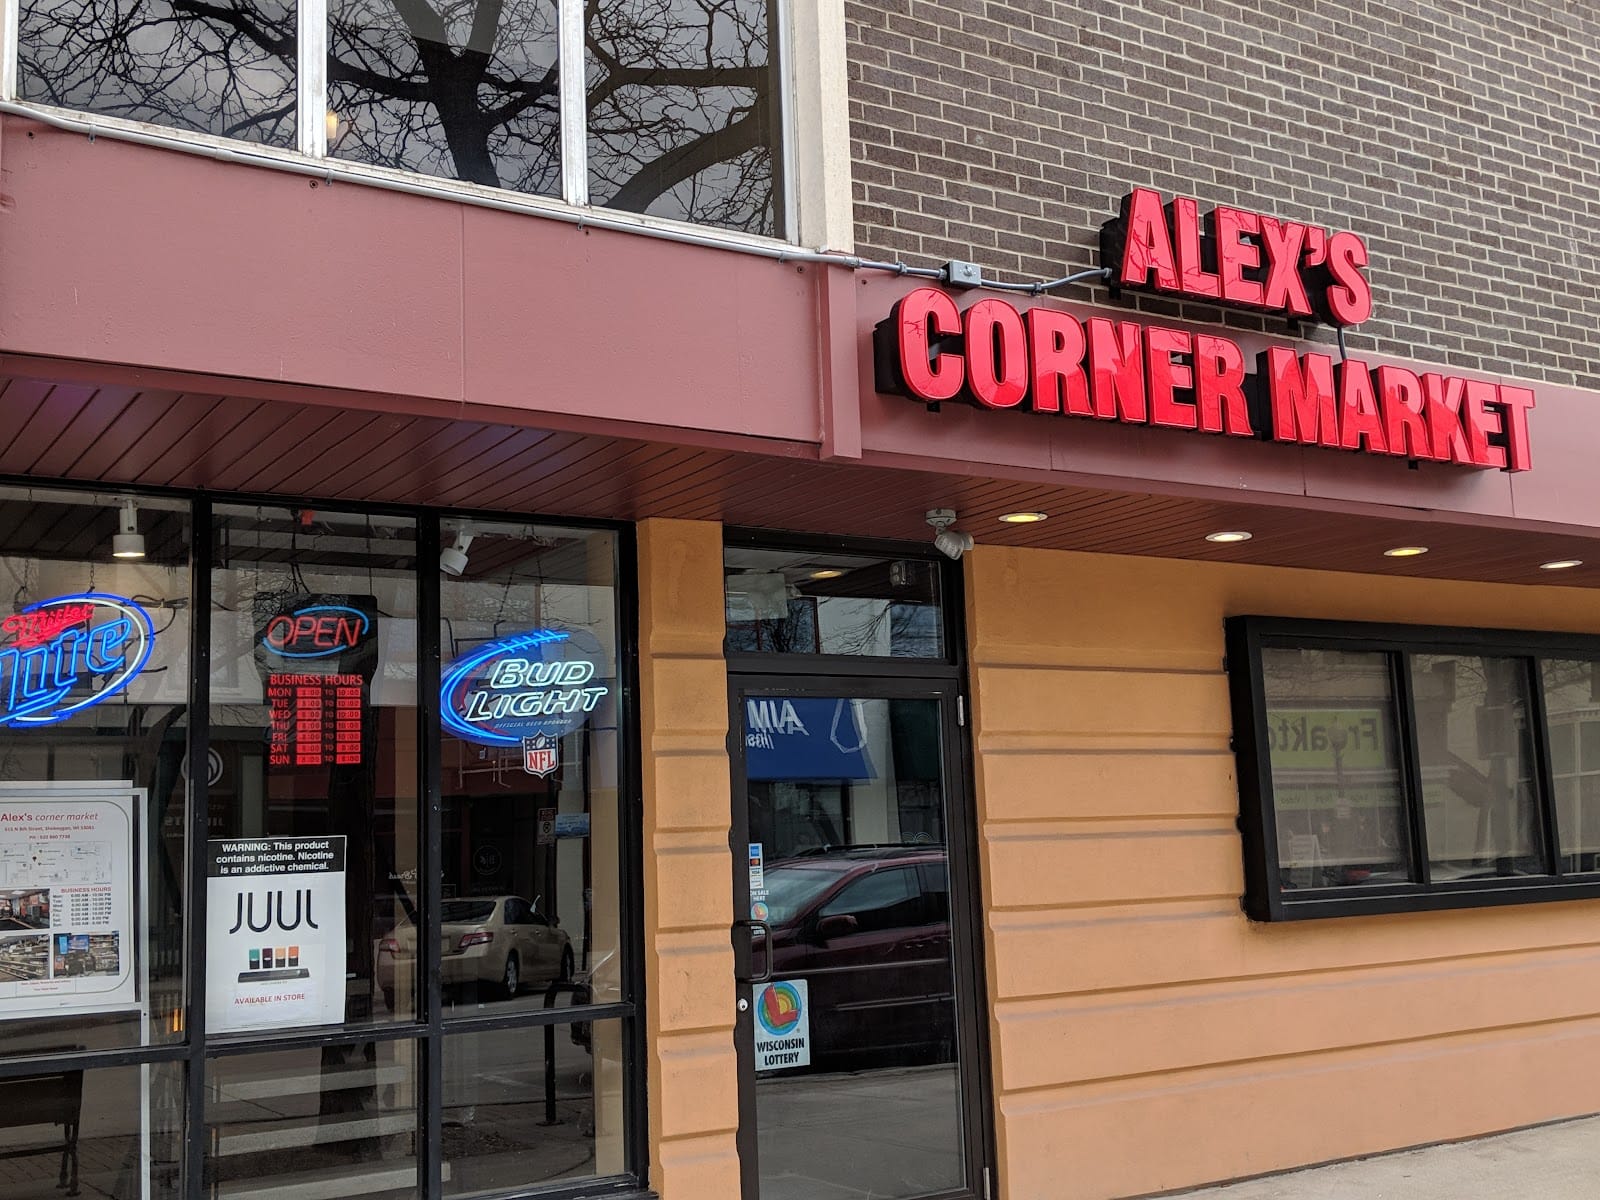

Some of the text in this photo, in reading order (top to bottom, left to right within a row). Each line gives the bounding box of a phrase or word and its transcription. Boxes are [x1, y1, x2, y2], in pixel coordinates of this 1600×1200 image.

[1118, 186, 1372, 327] ALEX'S
[897, 286, 1535, 473] CORNER MARKET
[2, 603, 96, 647] Miller
[267, 615, 362, 647] OPEN
[270, 674, 363, 685] BUSINESS HOURS
[490, 658, 595, 689] BUD
[268, 688, 292, 697] MON
[272, 699, 289, 708] TUE
[463, 687, 609, 722] LIGHT
[269, 710, 292, 719] WED
[271, 721, 290, 730] THU
[272, 732, 288, 742] FRI
[270, 743, 288, 753] SAT
[270, 754, 290, 764] SUN
[528, 749, 555, 771] NFL
[0, 812, 33, 822] Alex's
[66, 812, 98, 821] market
[222, 841, 329, 852] WARNING: This product
[216, 851, 334, 864] contains nicotine. Nicotine
[220, 862, 329, 874] is an addictive chemical.
[229, 888, 319, 935] JUUL
[234, 993, 305, 1005] AVAILABLE IN STORE
[757, 1037, 805, 1053] WISCONSIN
[764, 1051, 799, 1066] LOTTERY
